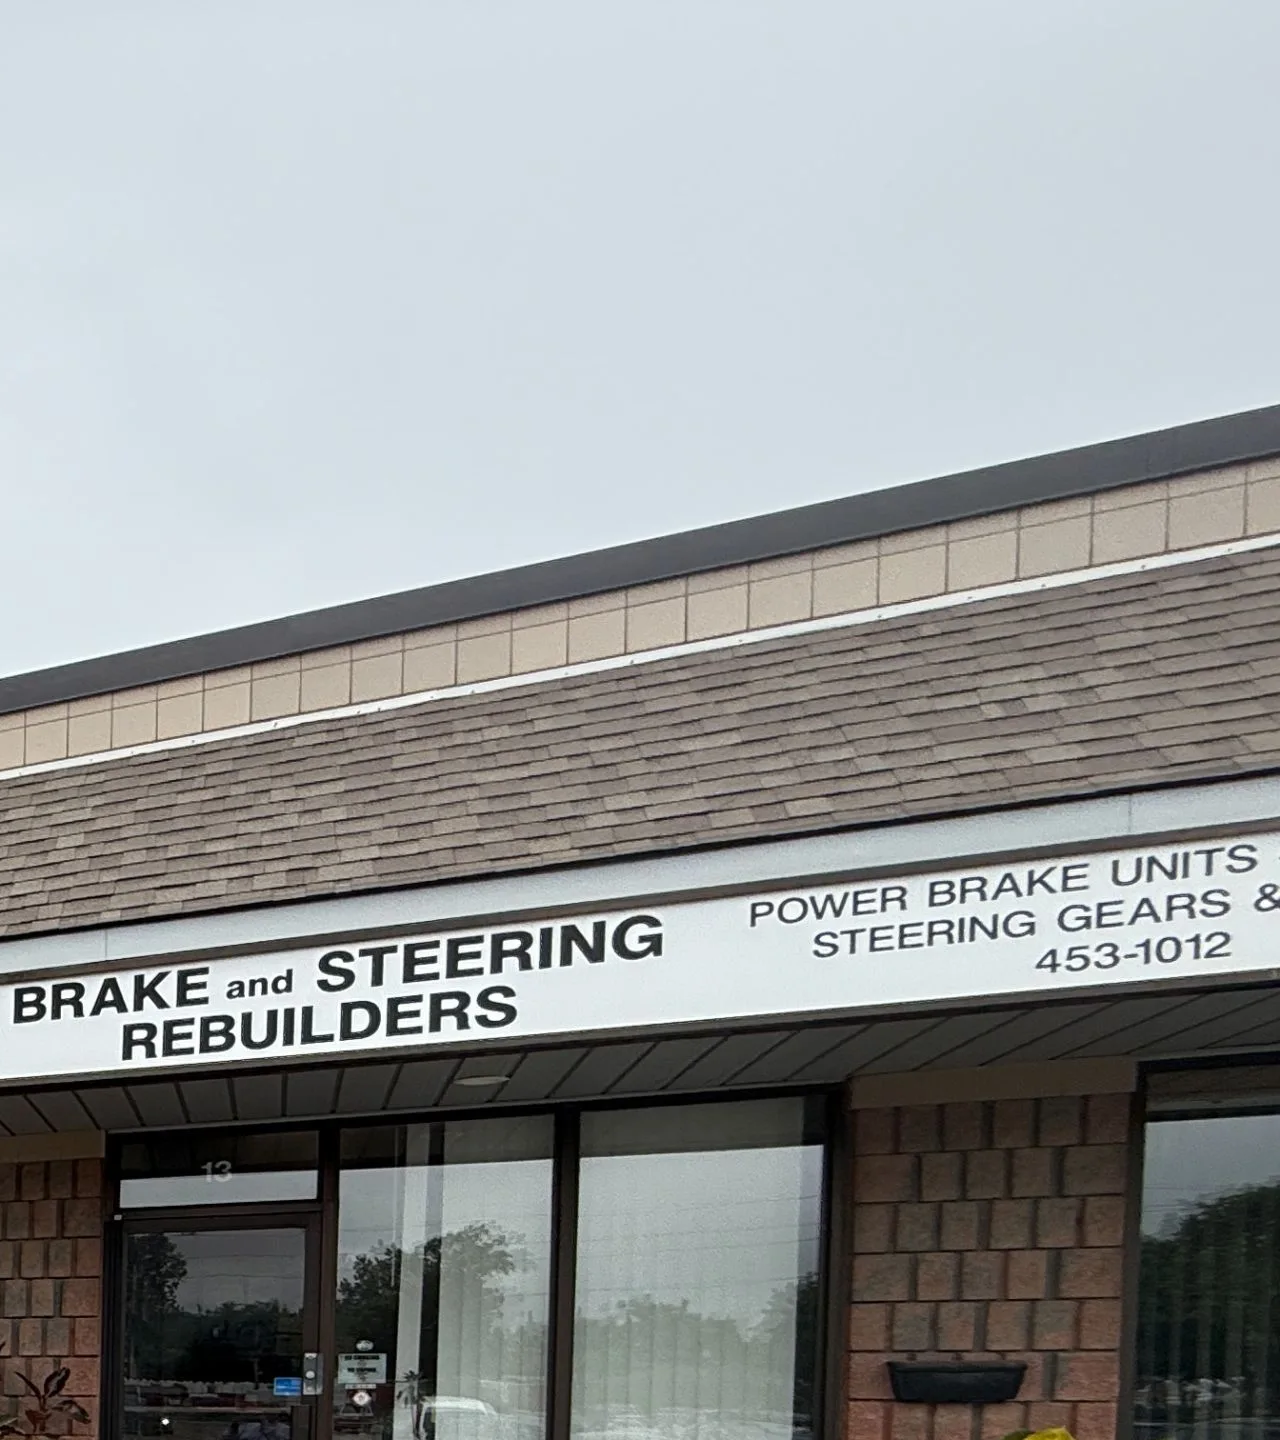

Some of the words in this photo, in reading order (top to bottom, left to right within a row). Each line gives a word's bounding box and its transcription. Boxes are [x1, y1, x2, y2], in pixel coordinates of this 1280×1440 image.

[750, 885, 908, 928] POWER
[928, 863, 1090, 908] BRAKE
[1111, 844, 1258, 887] UNITS
[813, 910, 1036, 959] STEERING
[1057, 888, 1231, 933] GEARS
[1253, 883, 1280, 913] &
[13, 966, 210, 1024] BRAKE
[226, 968, 293, 1000] and
[316, 914, 663, 993] STEERING
[1035, 931, 1231, 973] 453-1012
[121, 985, 517, 1061] REBUILDERS
[201, 1160, 232, 1183] 13
